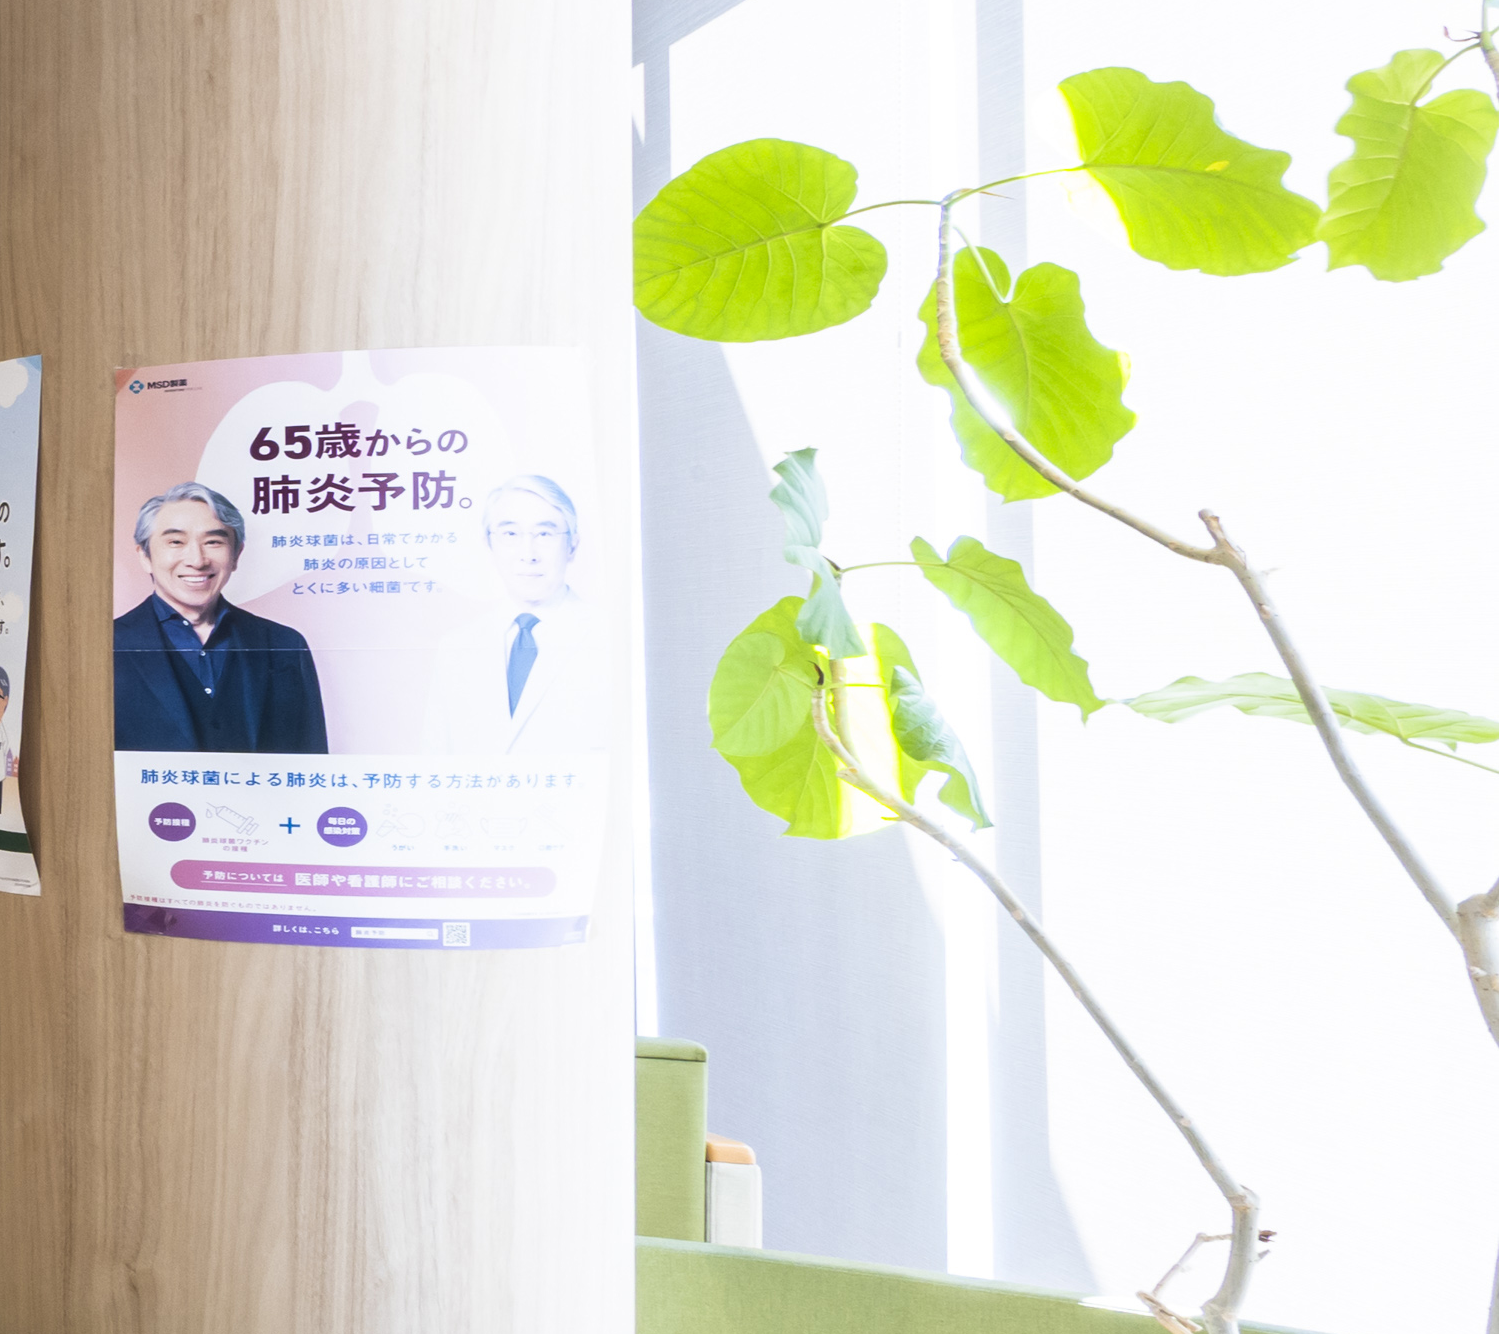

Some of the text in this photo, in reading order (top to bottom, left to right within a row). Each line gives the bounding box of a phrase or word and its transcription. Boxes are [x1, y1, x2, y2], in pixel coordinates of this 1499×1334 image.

[147, 379, 188, 390] MSD製薬
[249, 422, 469, 462] 65歳からの
[251, 469, 473, 515] 肺炎予防。
[271, 531, 459, 549] 肺炎球菌は、日常でかかる
[303, 556, 429, 571] 肺炎の原因として
[140, 769, 585, 789] 肺炎球菌による肺炎は、予防する方法があります。
[153, 817, 190, 827] 予防接種
[327, 817, 356, 826] 毎日の
[323, 827, 361, 836] 感染対策
[201, 837, 269, 846] 肺炎球菌ワクチン
[223, 845, 248, 853] の接種
[391, 844, 415, 852] うがい
[202, 870, 531, 890] 予防については 医師や看護師にご相談ください。
[272, 924, 340, 935] 詳しくは、こちら
